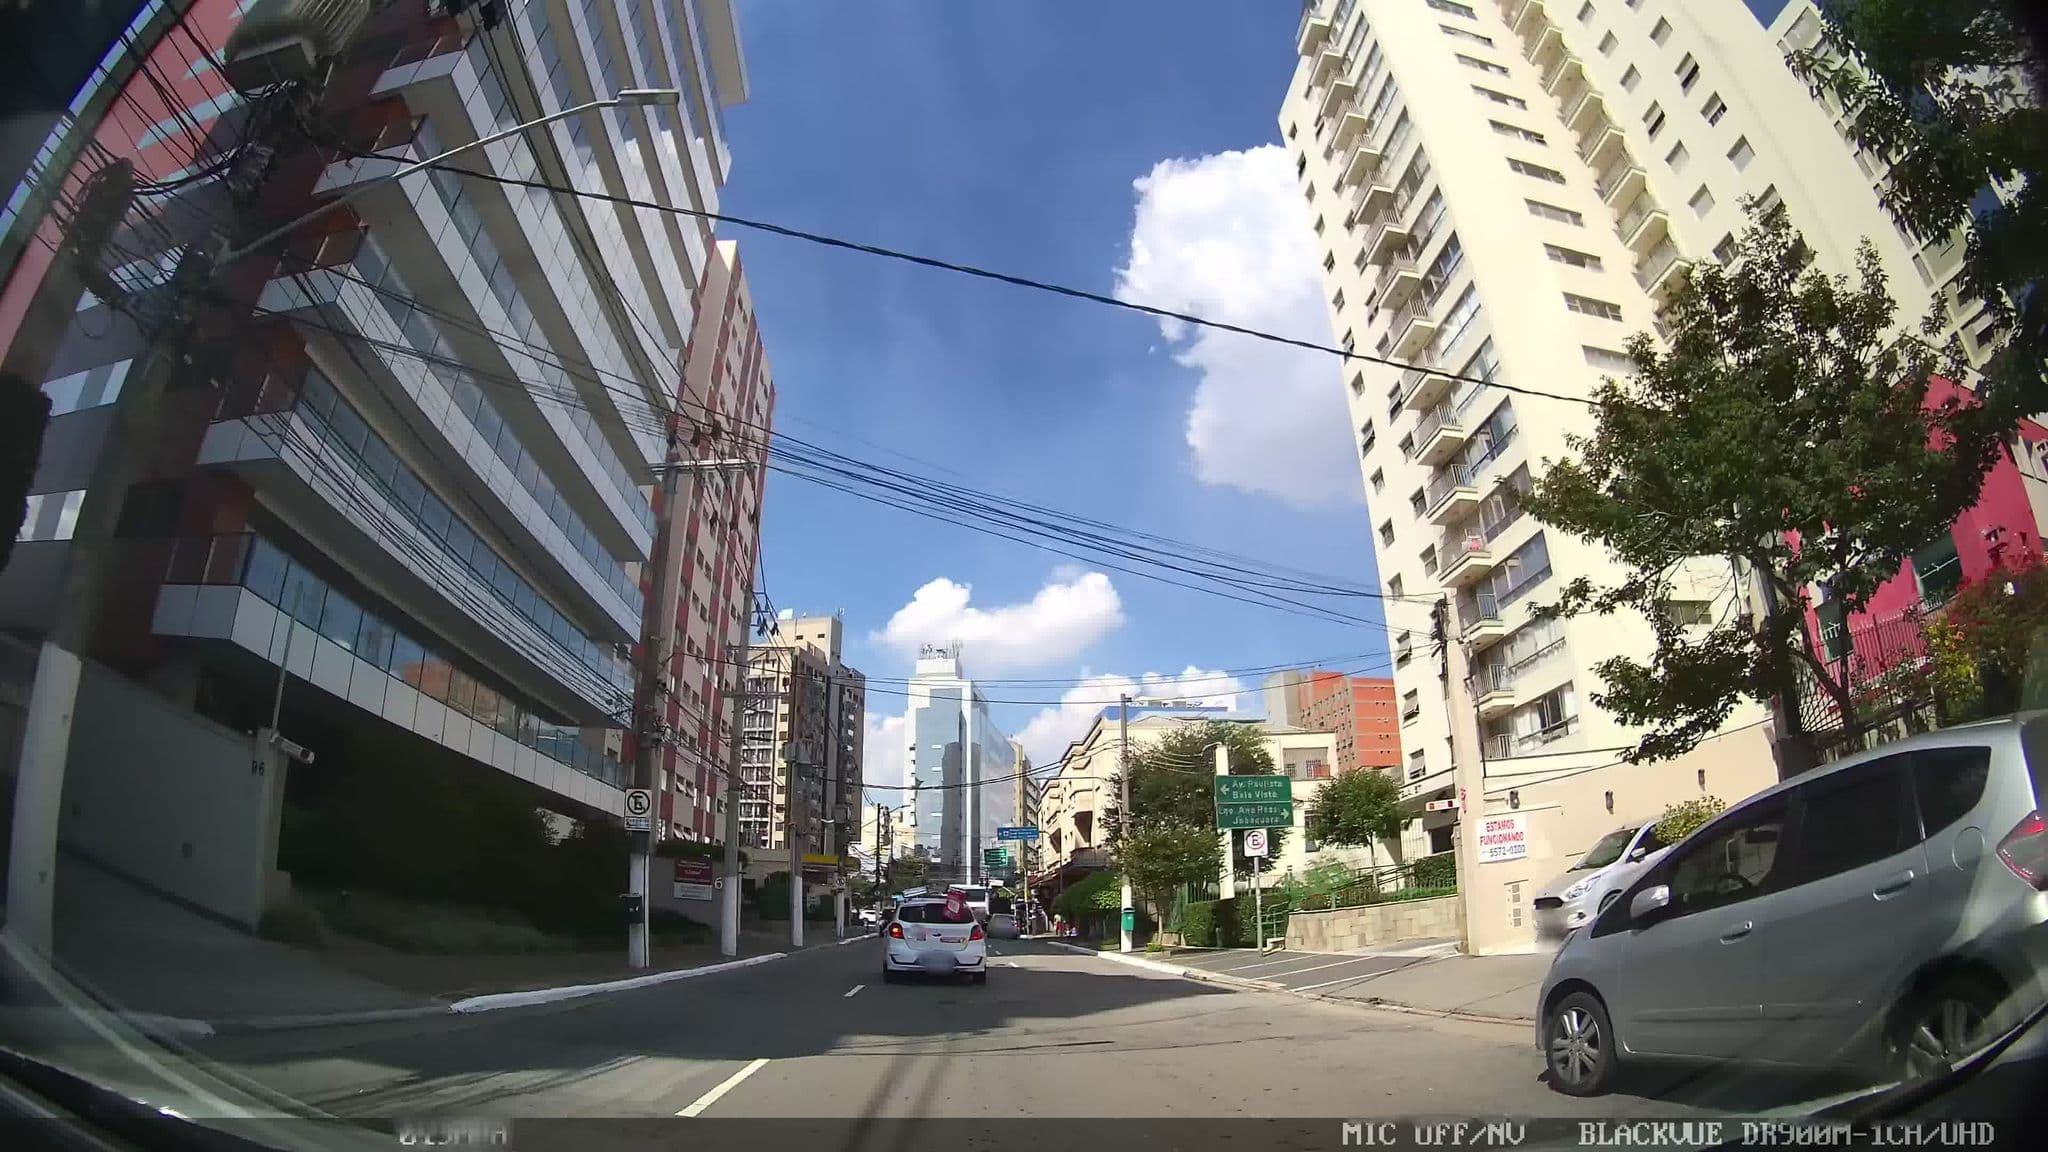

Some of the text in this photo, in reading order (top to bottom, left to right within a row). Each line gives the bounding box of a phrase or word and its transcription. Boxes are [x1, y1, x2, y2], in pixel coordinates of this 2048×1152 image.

[1247, 780, 1283, 788] Paulista
[1255, 790, 1278, 799] Vista
[1486, 819, 1515, 832] ESTAMOS
[1480, 831, 1524, 846] FUNCIONANDO
